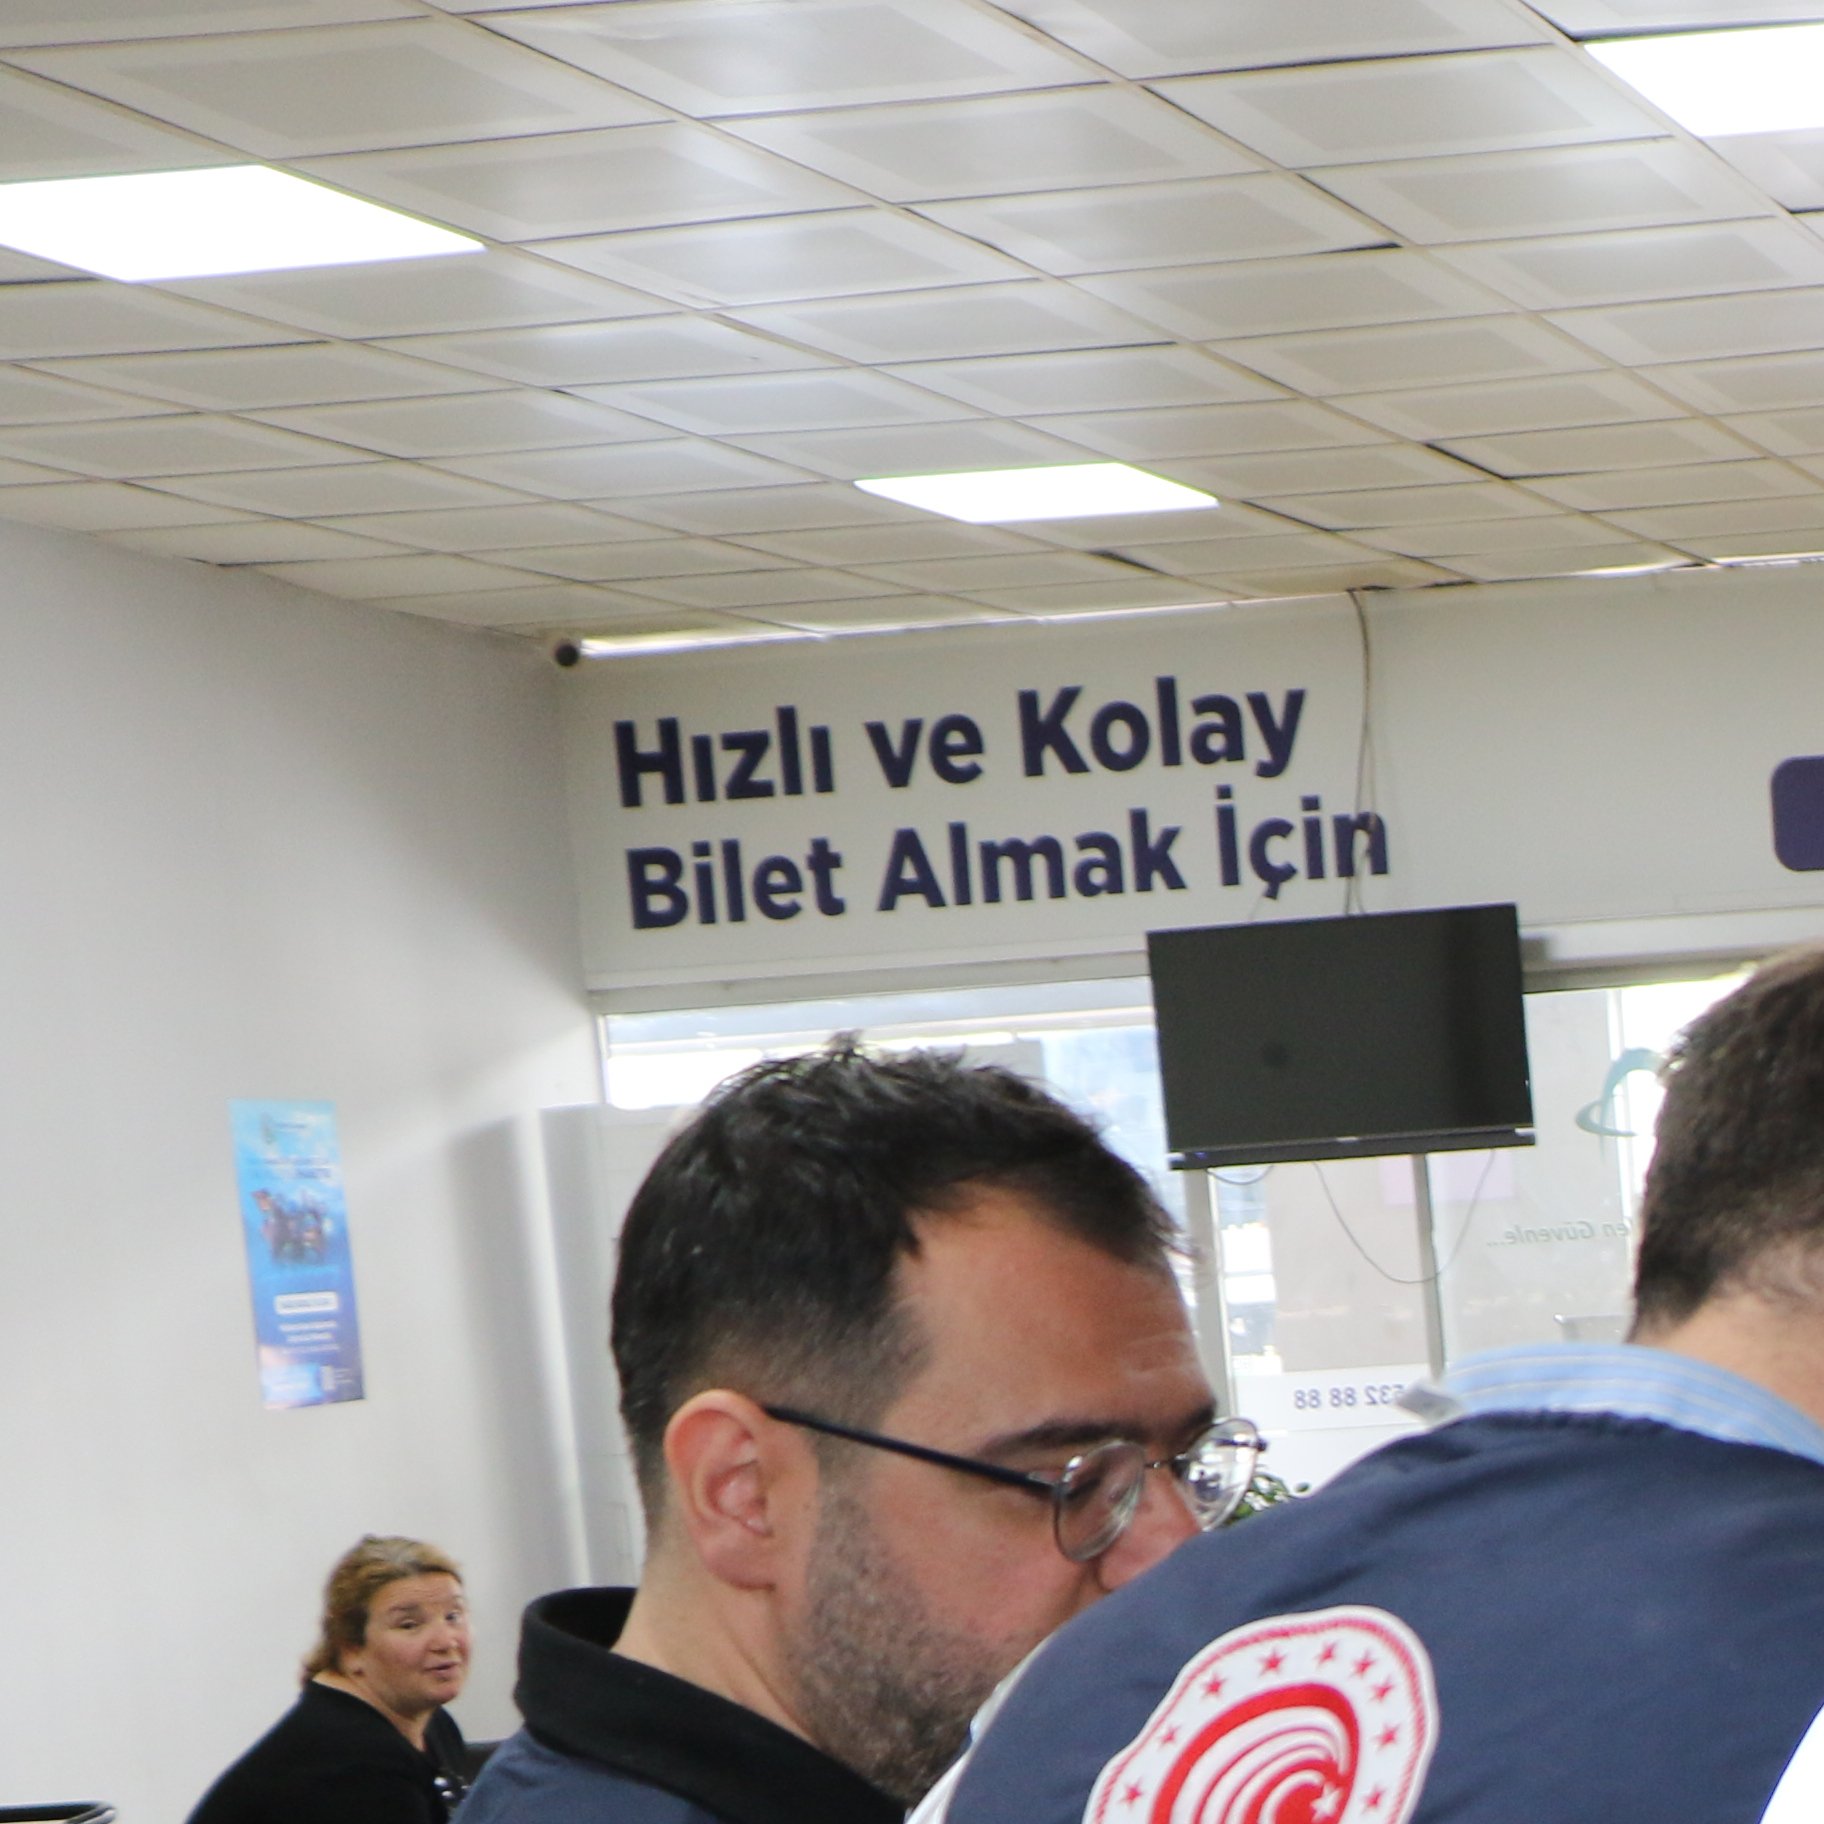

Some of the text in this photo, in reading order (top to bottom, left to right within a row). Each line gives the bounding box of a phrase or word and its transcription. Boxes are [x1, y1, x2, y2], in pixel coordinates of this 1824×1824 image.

[613, 674, 1308, 811] Hızlı ve Kolay
[624, 783, 1391, 931] Bilet Almak İçin
